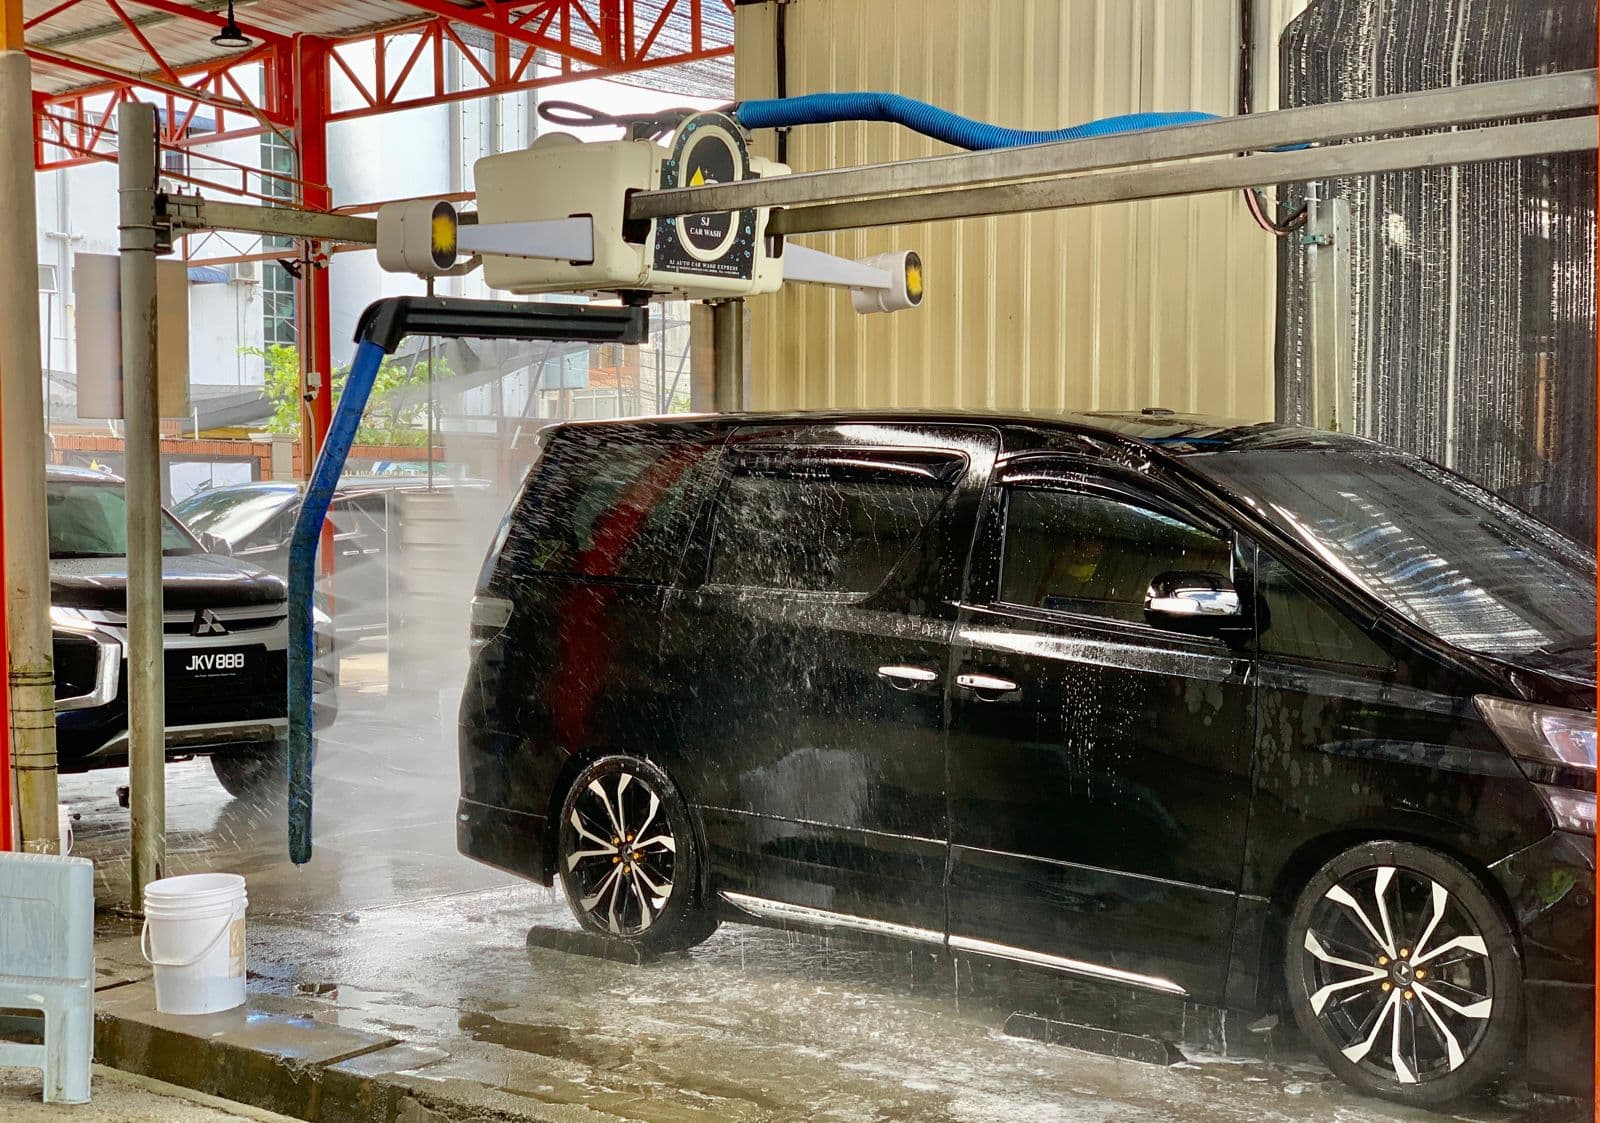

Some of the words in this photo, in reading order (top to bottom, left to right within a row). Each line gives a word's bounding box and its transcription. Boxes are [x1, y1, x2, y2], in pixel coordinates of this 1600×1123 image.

[701, 216, 710, 226] SJ
[690, 227, 703, 236] CAR
[704, 228, 722, 238] WASH
[717, 263, 738, 271] EXPRESS
[185, 653, 245, 670] JKV888
